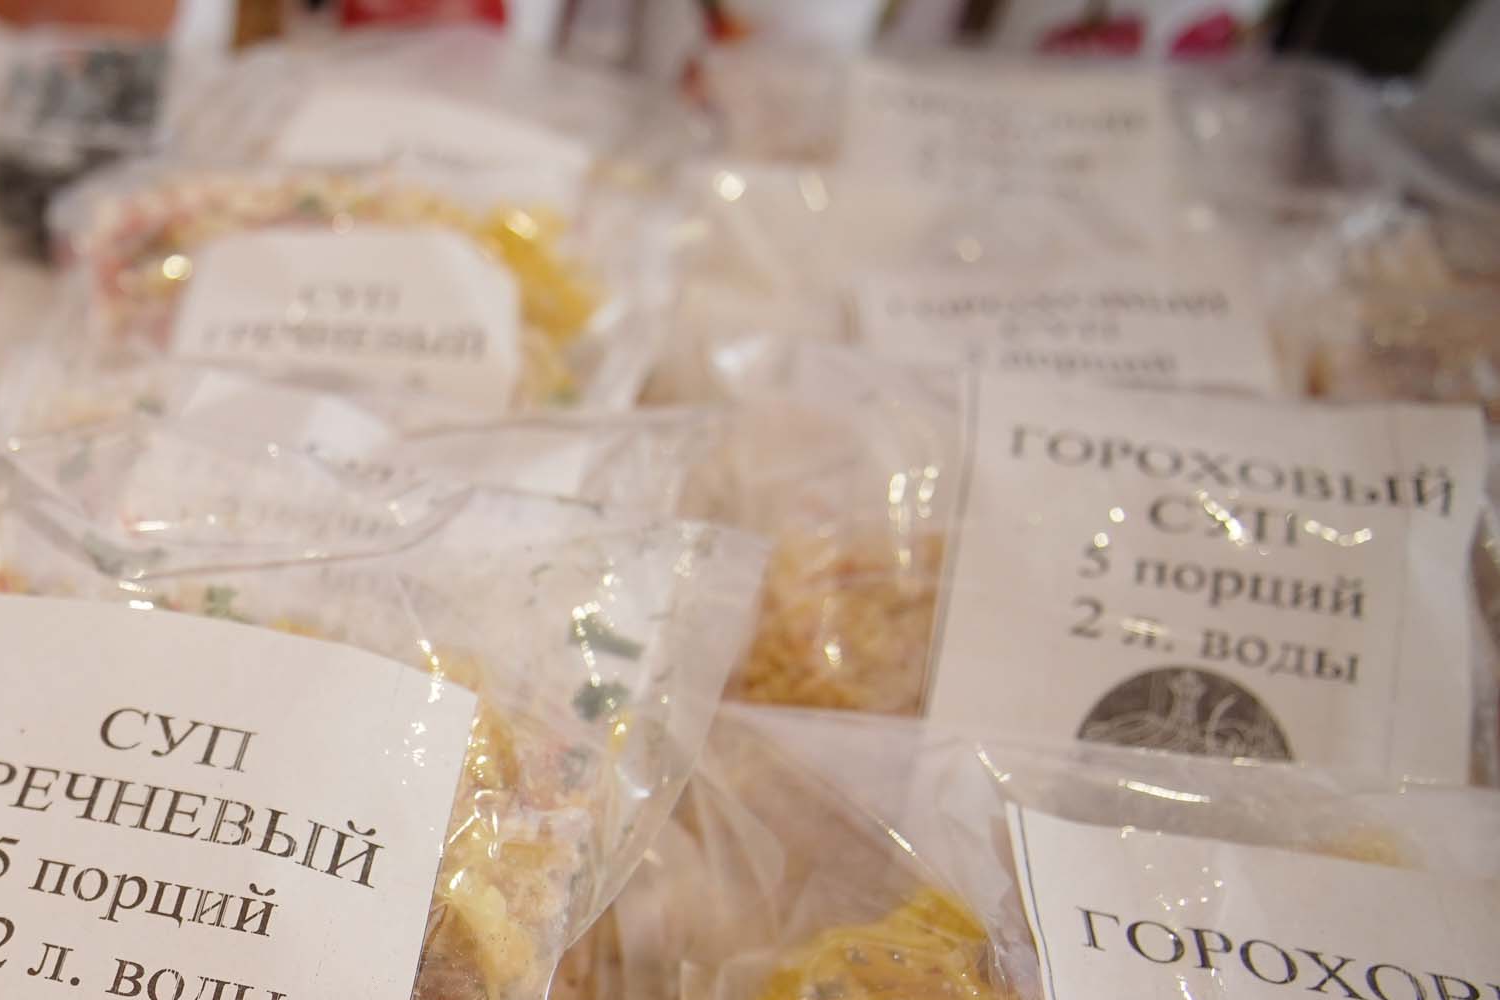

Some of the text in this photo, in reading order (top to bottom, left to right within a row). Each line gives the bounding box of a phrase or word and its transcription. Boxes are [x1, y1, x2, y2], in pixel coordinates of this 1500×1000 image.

[1010, 424, 1454, 516] ГОРОХОВЫЙ
[1148, 493, 1297, 546] СУП
[1079, 542, 1364, 619] 5 порций
[1070, 597, 1104, 638] 2
[1200, 628, 1359, 683] воды
[99, 708, 257, 773] СУП
[28, 857, 279, 937] порций
[27, 942, 80, 987] л.
